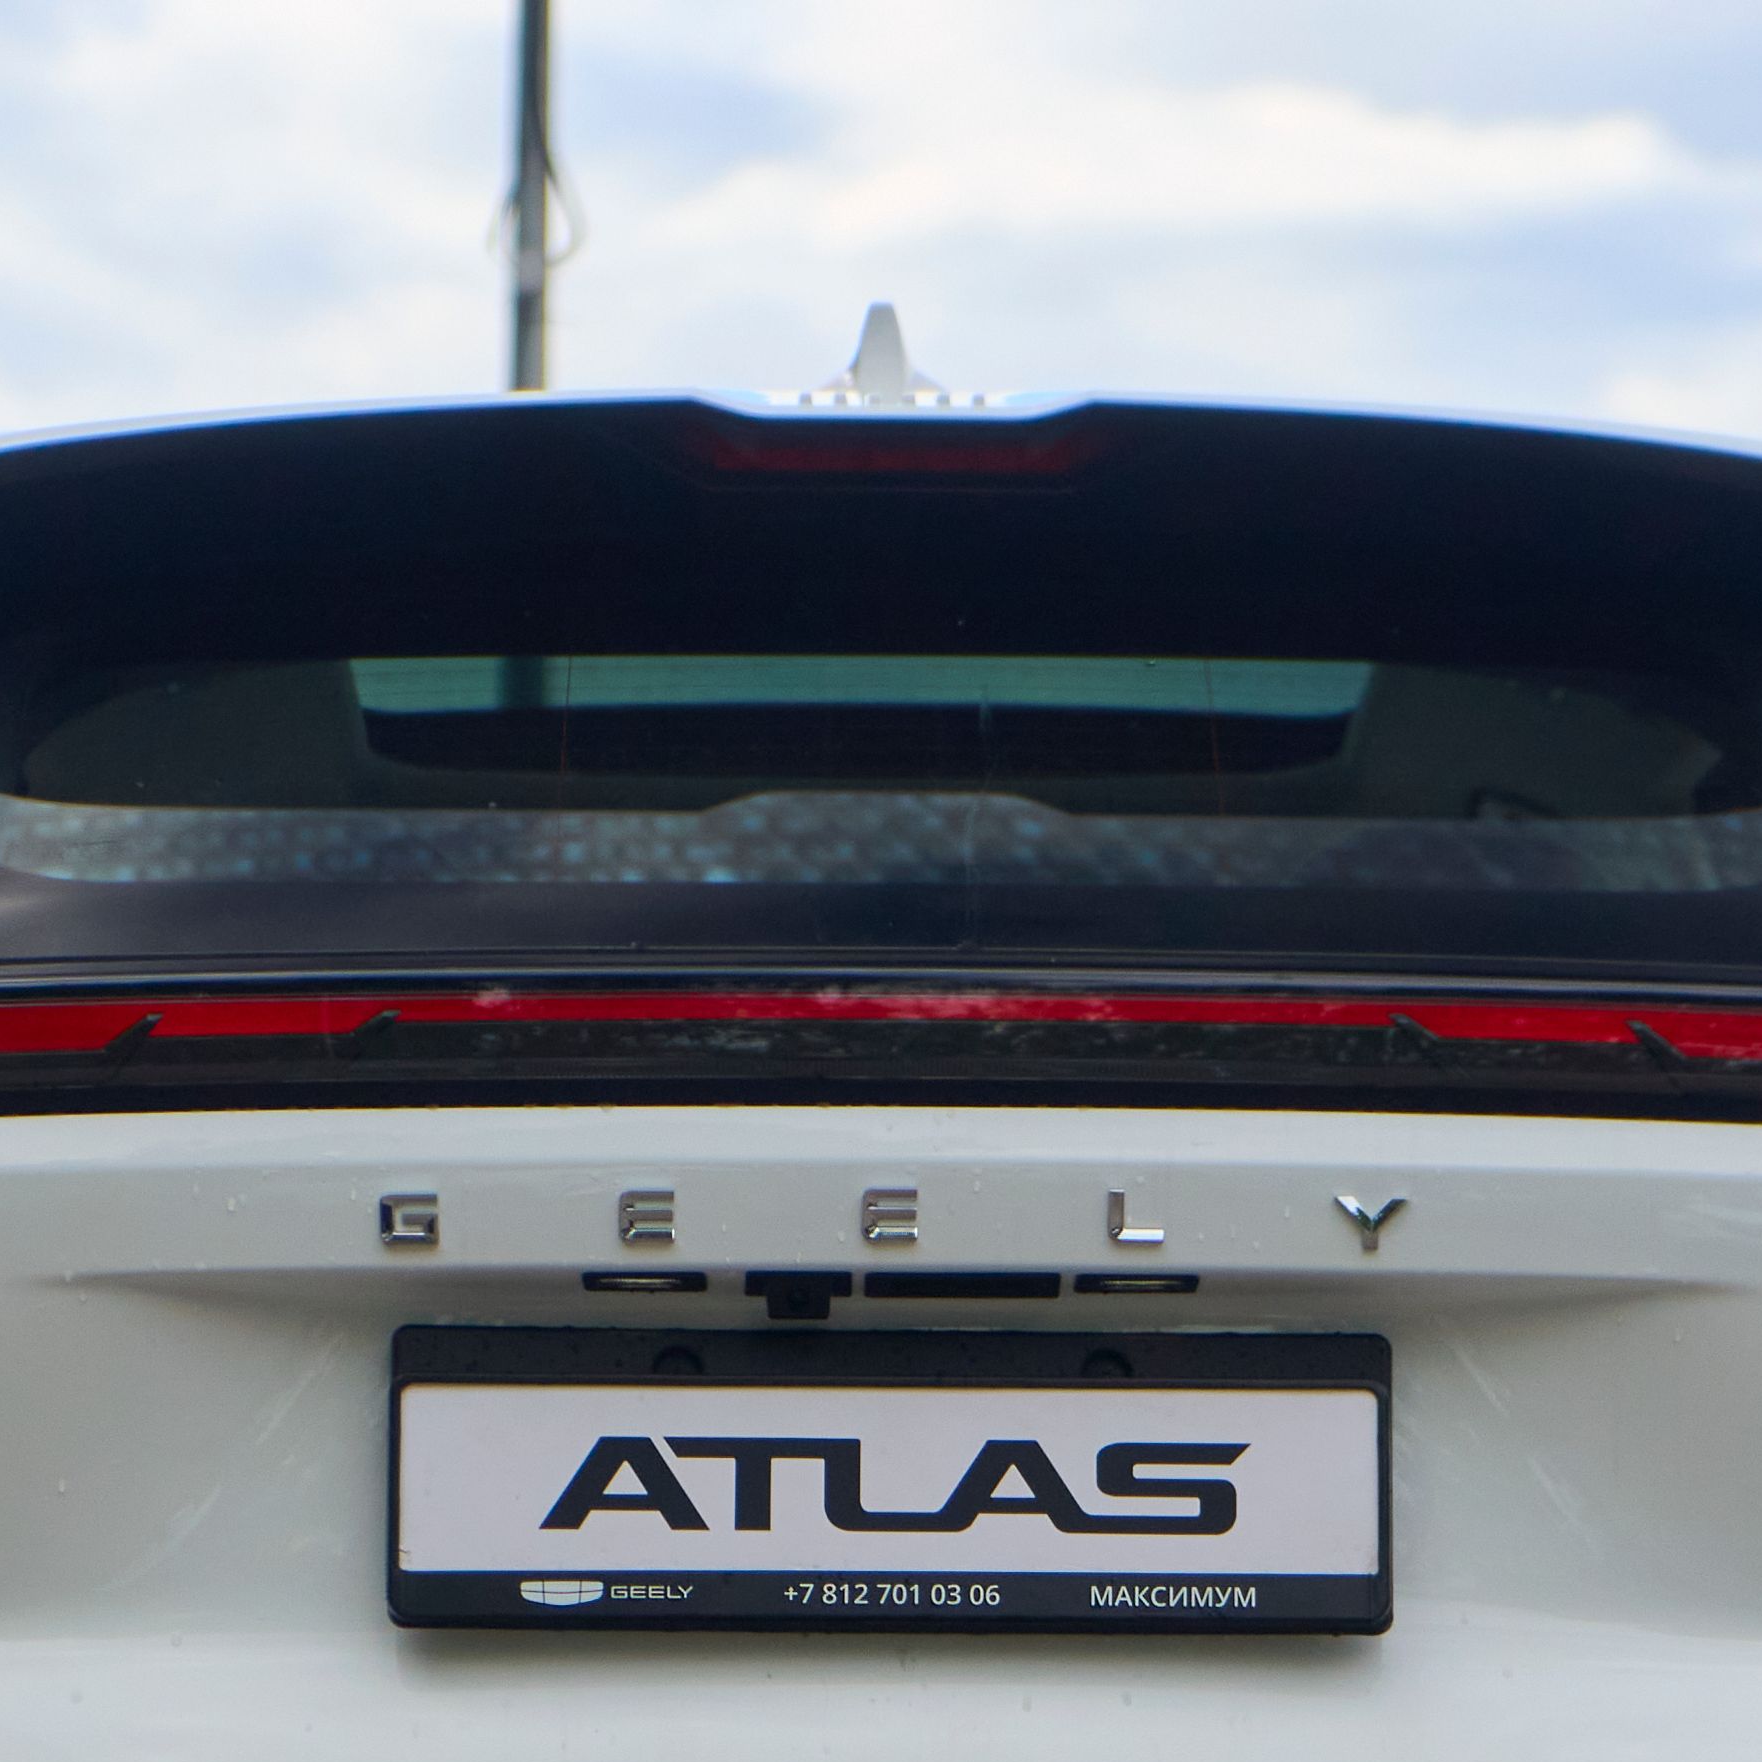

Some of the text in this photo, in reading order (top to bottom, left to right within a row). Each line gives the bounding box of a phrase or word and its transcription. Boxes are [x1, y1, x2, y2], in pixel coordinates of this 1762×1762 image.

[379, 1188, 1408, 1251] GEELY
[538, 1436, 1252, 1536] ATLAS
[610, 1585, 694, 1600] GEELY
[783, 1583, 1001, 1606] +7 812 701 03 06
[1090, 1585, 1257, 1608] МАКСИМУМ
